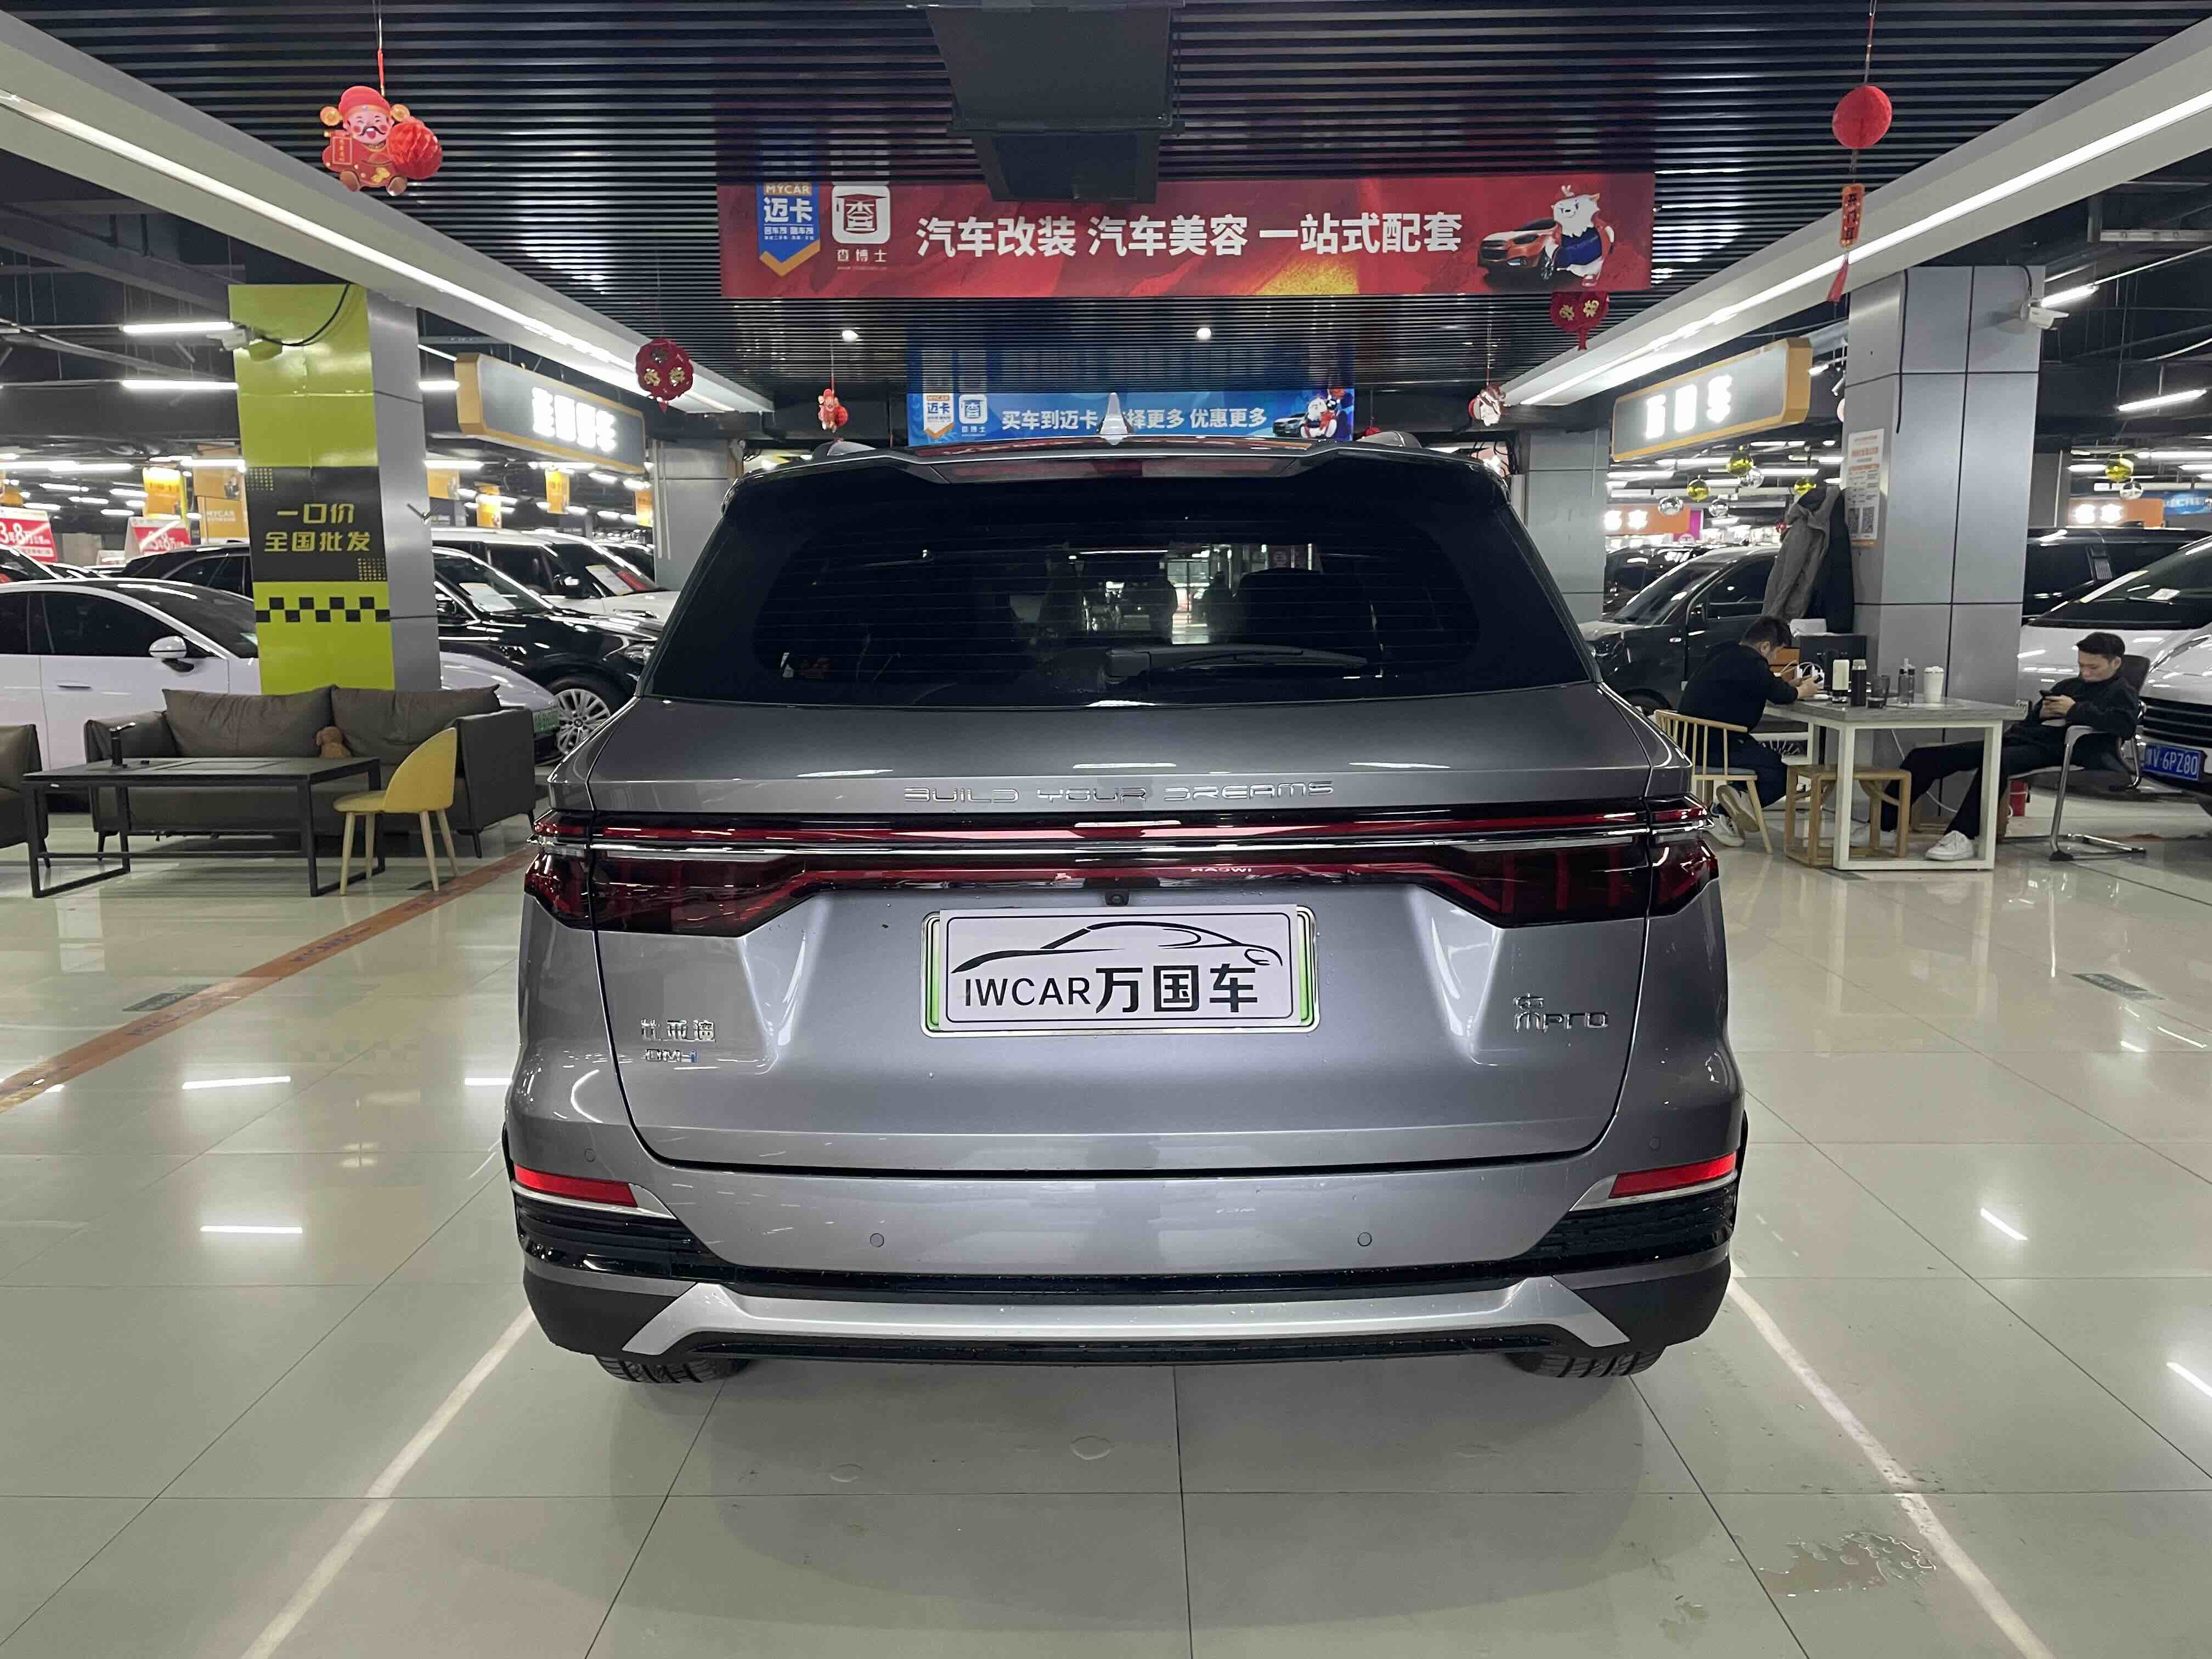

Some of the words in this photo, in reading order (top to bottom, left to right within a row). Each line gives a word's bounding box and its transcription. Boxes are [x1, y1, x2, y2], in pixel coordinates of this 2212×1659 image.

[765, 184, 810, 194] MYCAR
[763, 197, 812, 223] 迈卡
[916, 217, 1076, 258] 汽车改装
[1088, 215, 1248, 257] 汽车美容
[1259, 212, 1463, 255] 一站式配套
[837, 249, 887, 262] 查博士
[927, 402, 950, 414] 迈卡
[1002, 410, 1098, 431] 买车到迈卡
[1119, 409, 1185, 430] 择更多
[1189, 407, 1267, 428] 优惠更多
[276, 503, 356, 524] 一口价
[263, 531, 371, 552] 全国批发
[904, 786, 1018, 804] BUILD
[1037, 787, 1147, 804] YOUR
[1164, 781, 1335, 801] DREAMS
[964, 963, 1258, 1014] IWCAR万国车
